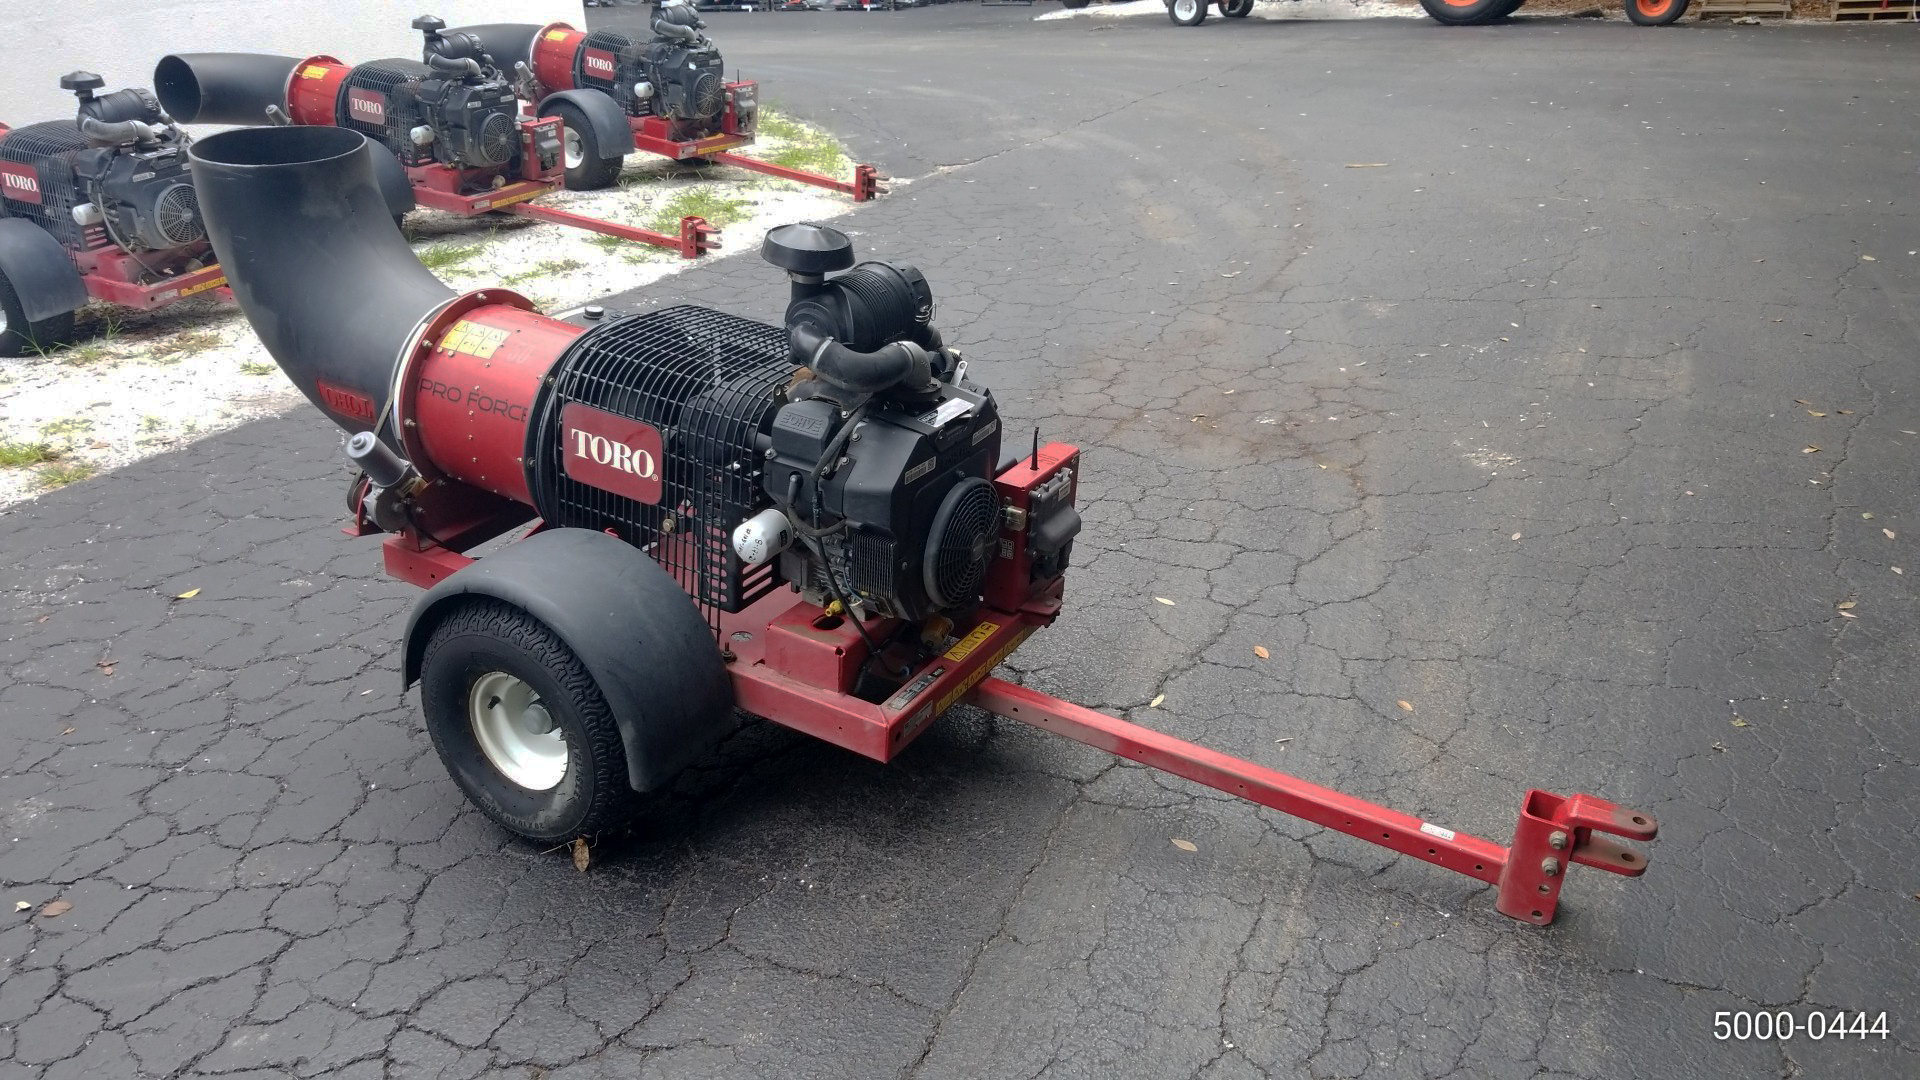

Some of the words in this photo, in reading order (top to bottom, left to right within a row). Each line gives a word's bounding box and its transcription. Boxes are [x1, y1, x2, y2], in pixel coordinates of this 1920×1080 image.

[586, 55, 613, 73] TORO
[351, 97, 383, 116] TORO
[1, 172, 38, 193] TORO
[419, 378, 462, 402] PRO
[571, 427, 656, 479] TORO
